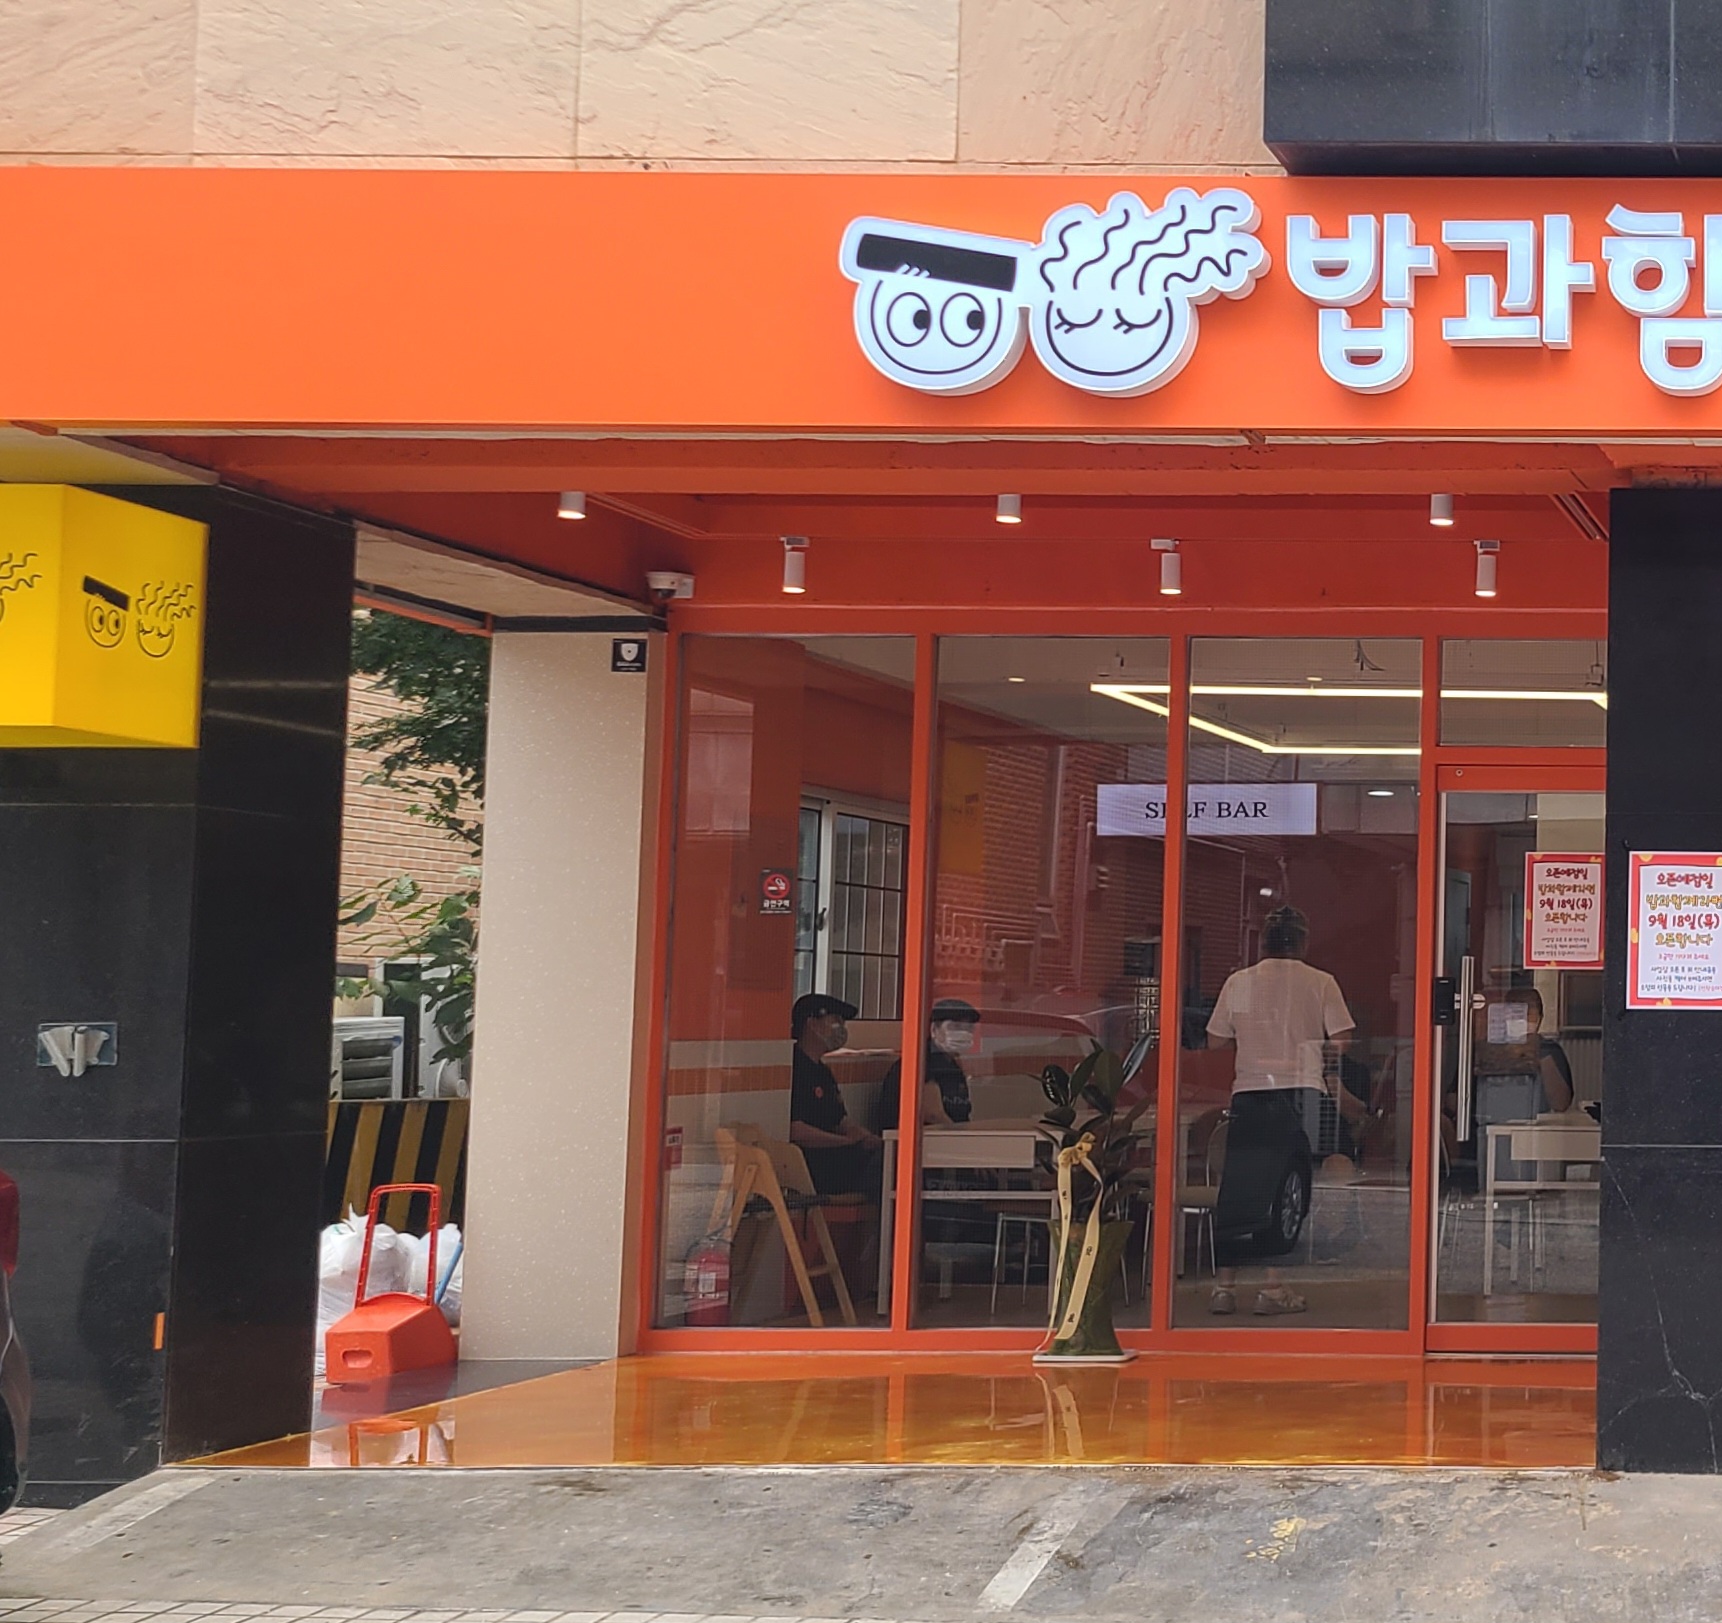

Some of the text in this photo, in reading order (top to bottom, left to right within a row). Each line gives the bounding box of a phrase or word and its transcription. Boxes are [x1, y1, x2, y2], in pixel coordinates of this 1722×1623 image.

[1145, 801, 1269, 818] SF BAR
[1539, 898, 1593, 910] 9월 18일(목)
[1648, 912, 1720, 930] 9월 18일(목)
[1655, 932, 1714, 949] 오픈합니다
